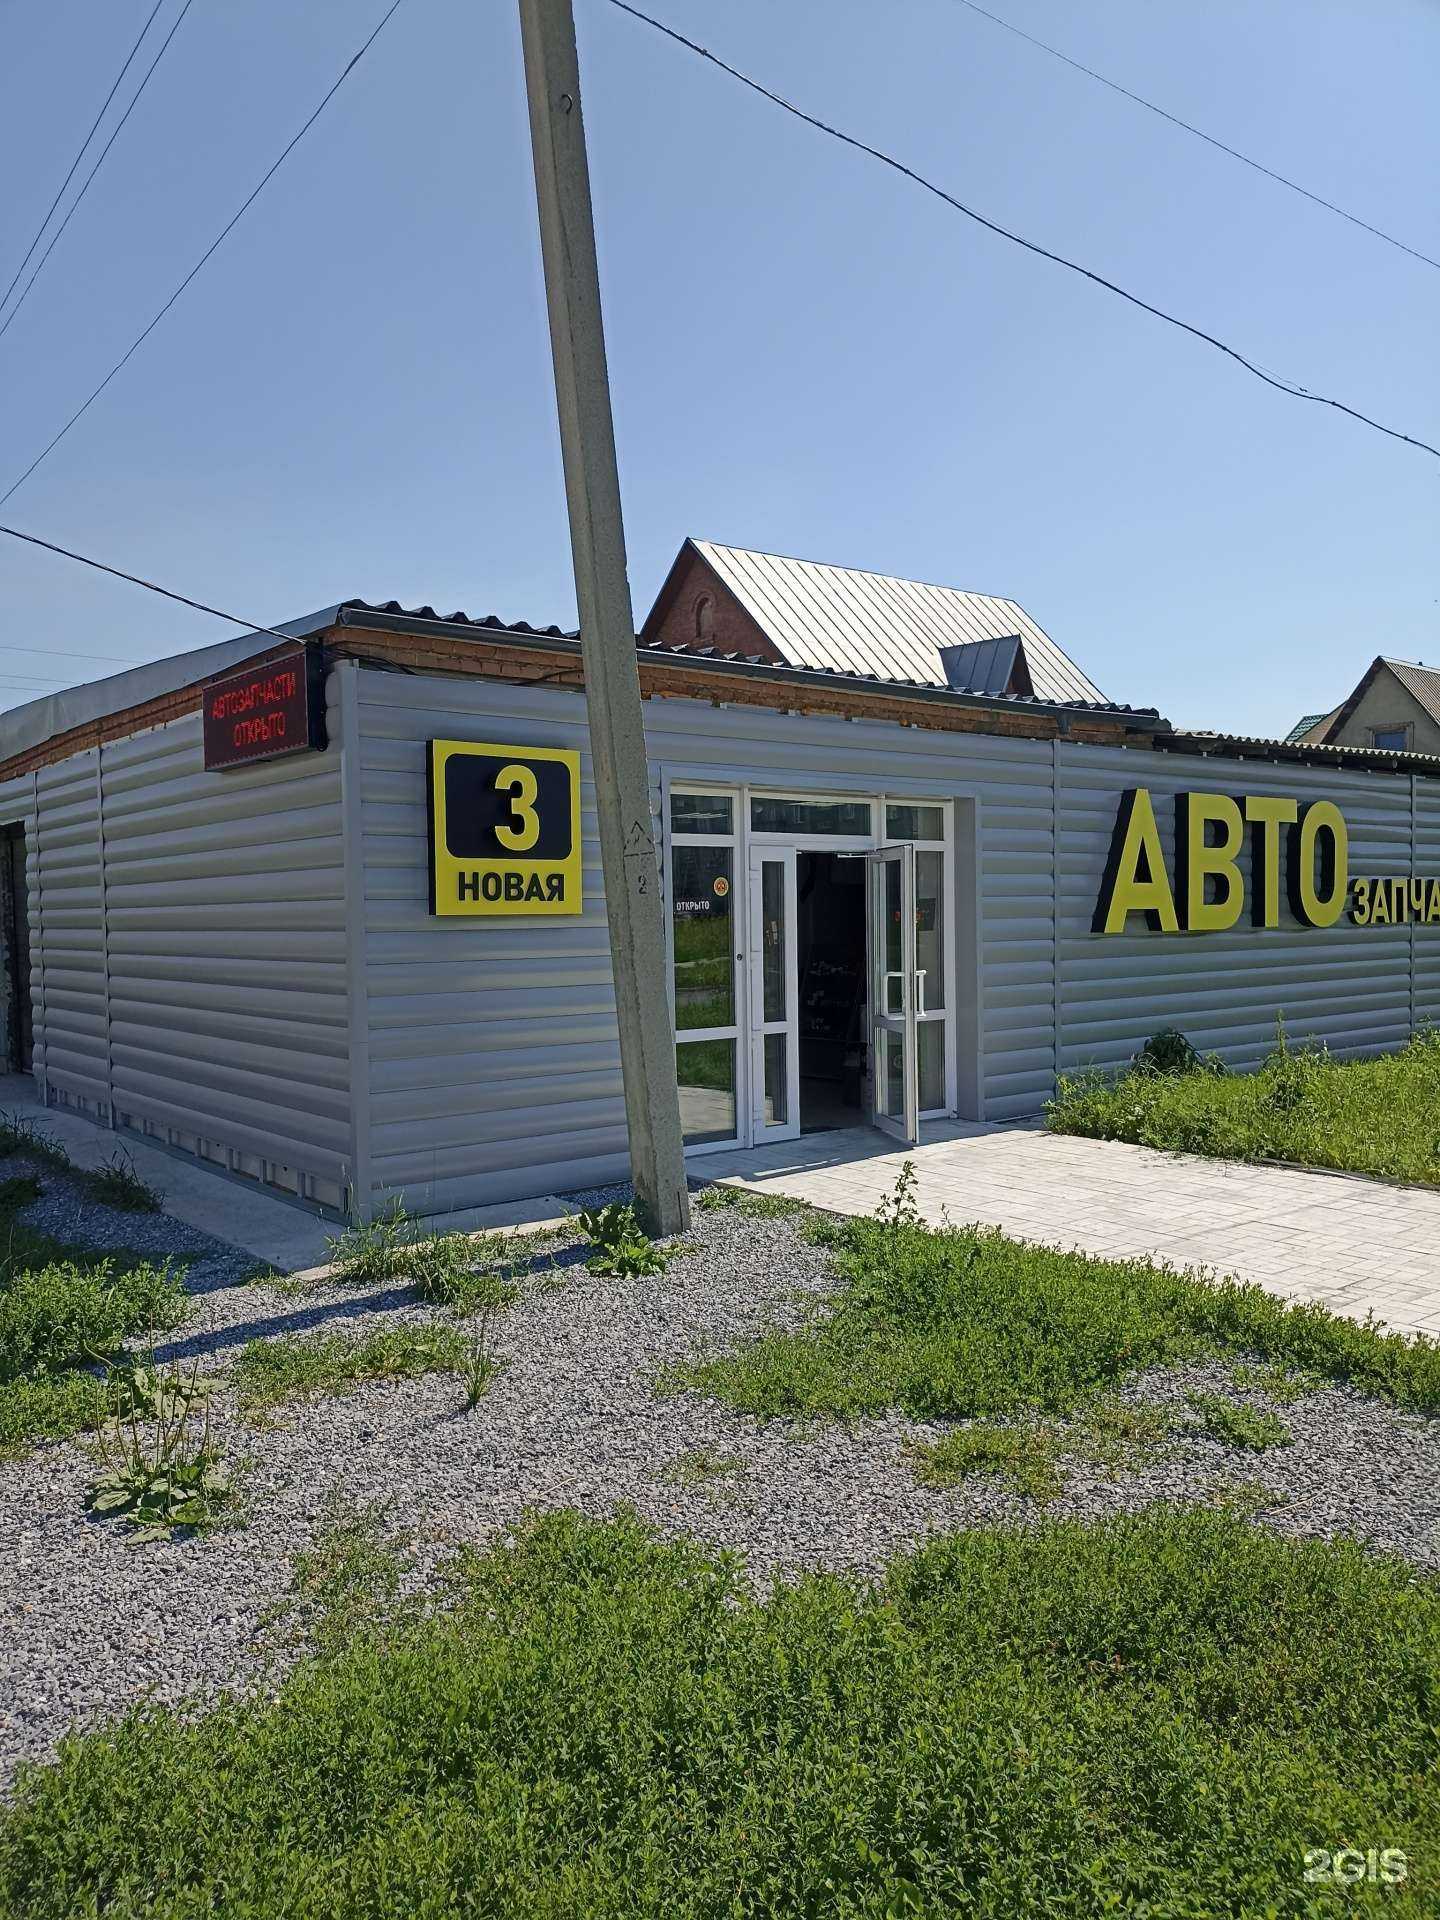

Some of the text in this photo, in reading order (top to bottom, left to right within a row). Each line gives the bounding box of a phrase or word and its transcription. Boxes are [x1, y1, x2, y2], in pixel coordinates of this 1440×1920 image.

[212, 672, 296, 719] АВТОЗАПЧАСТИ
[233, 711, 286, 747] ОТКРЫТО
[493, 764, 541, 852] 3
[1098, 787, 1349, 934] АВТО
[458, 871, 565, 902] НОВАЯ
[676, 900, 710, 911] ОТКРЫТО
